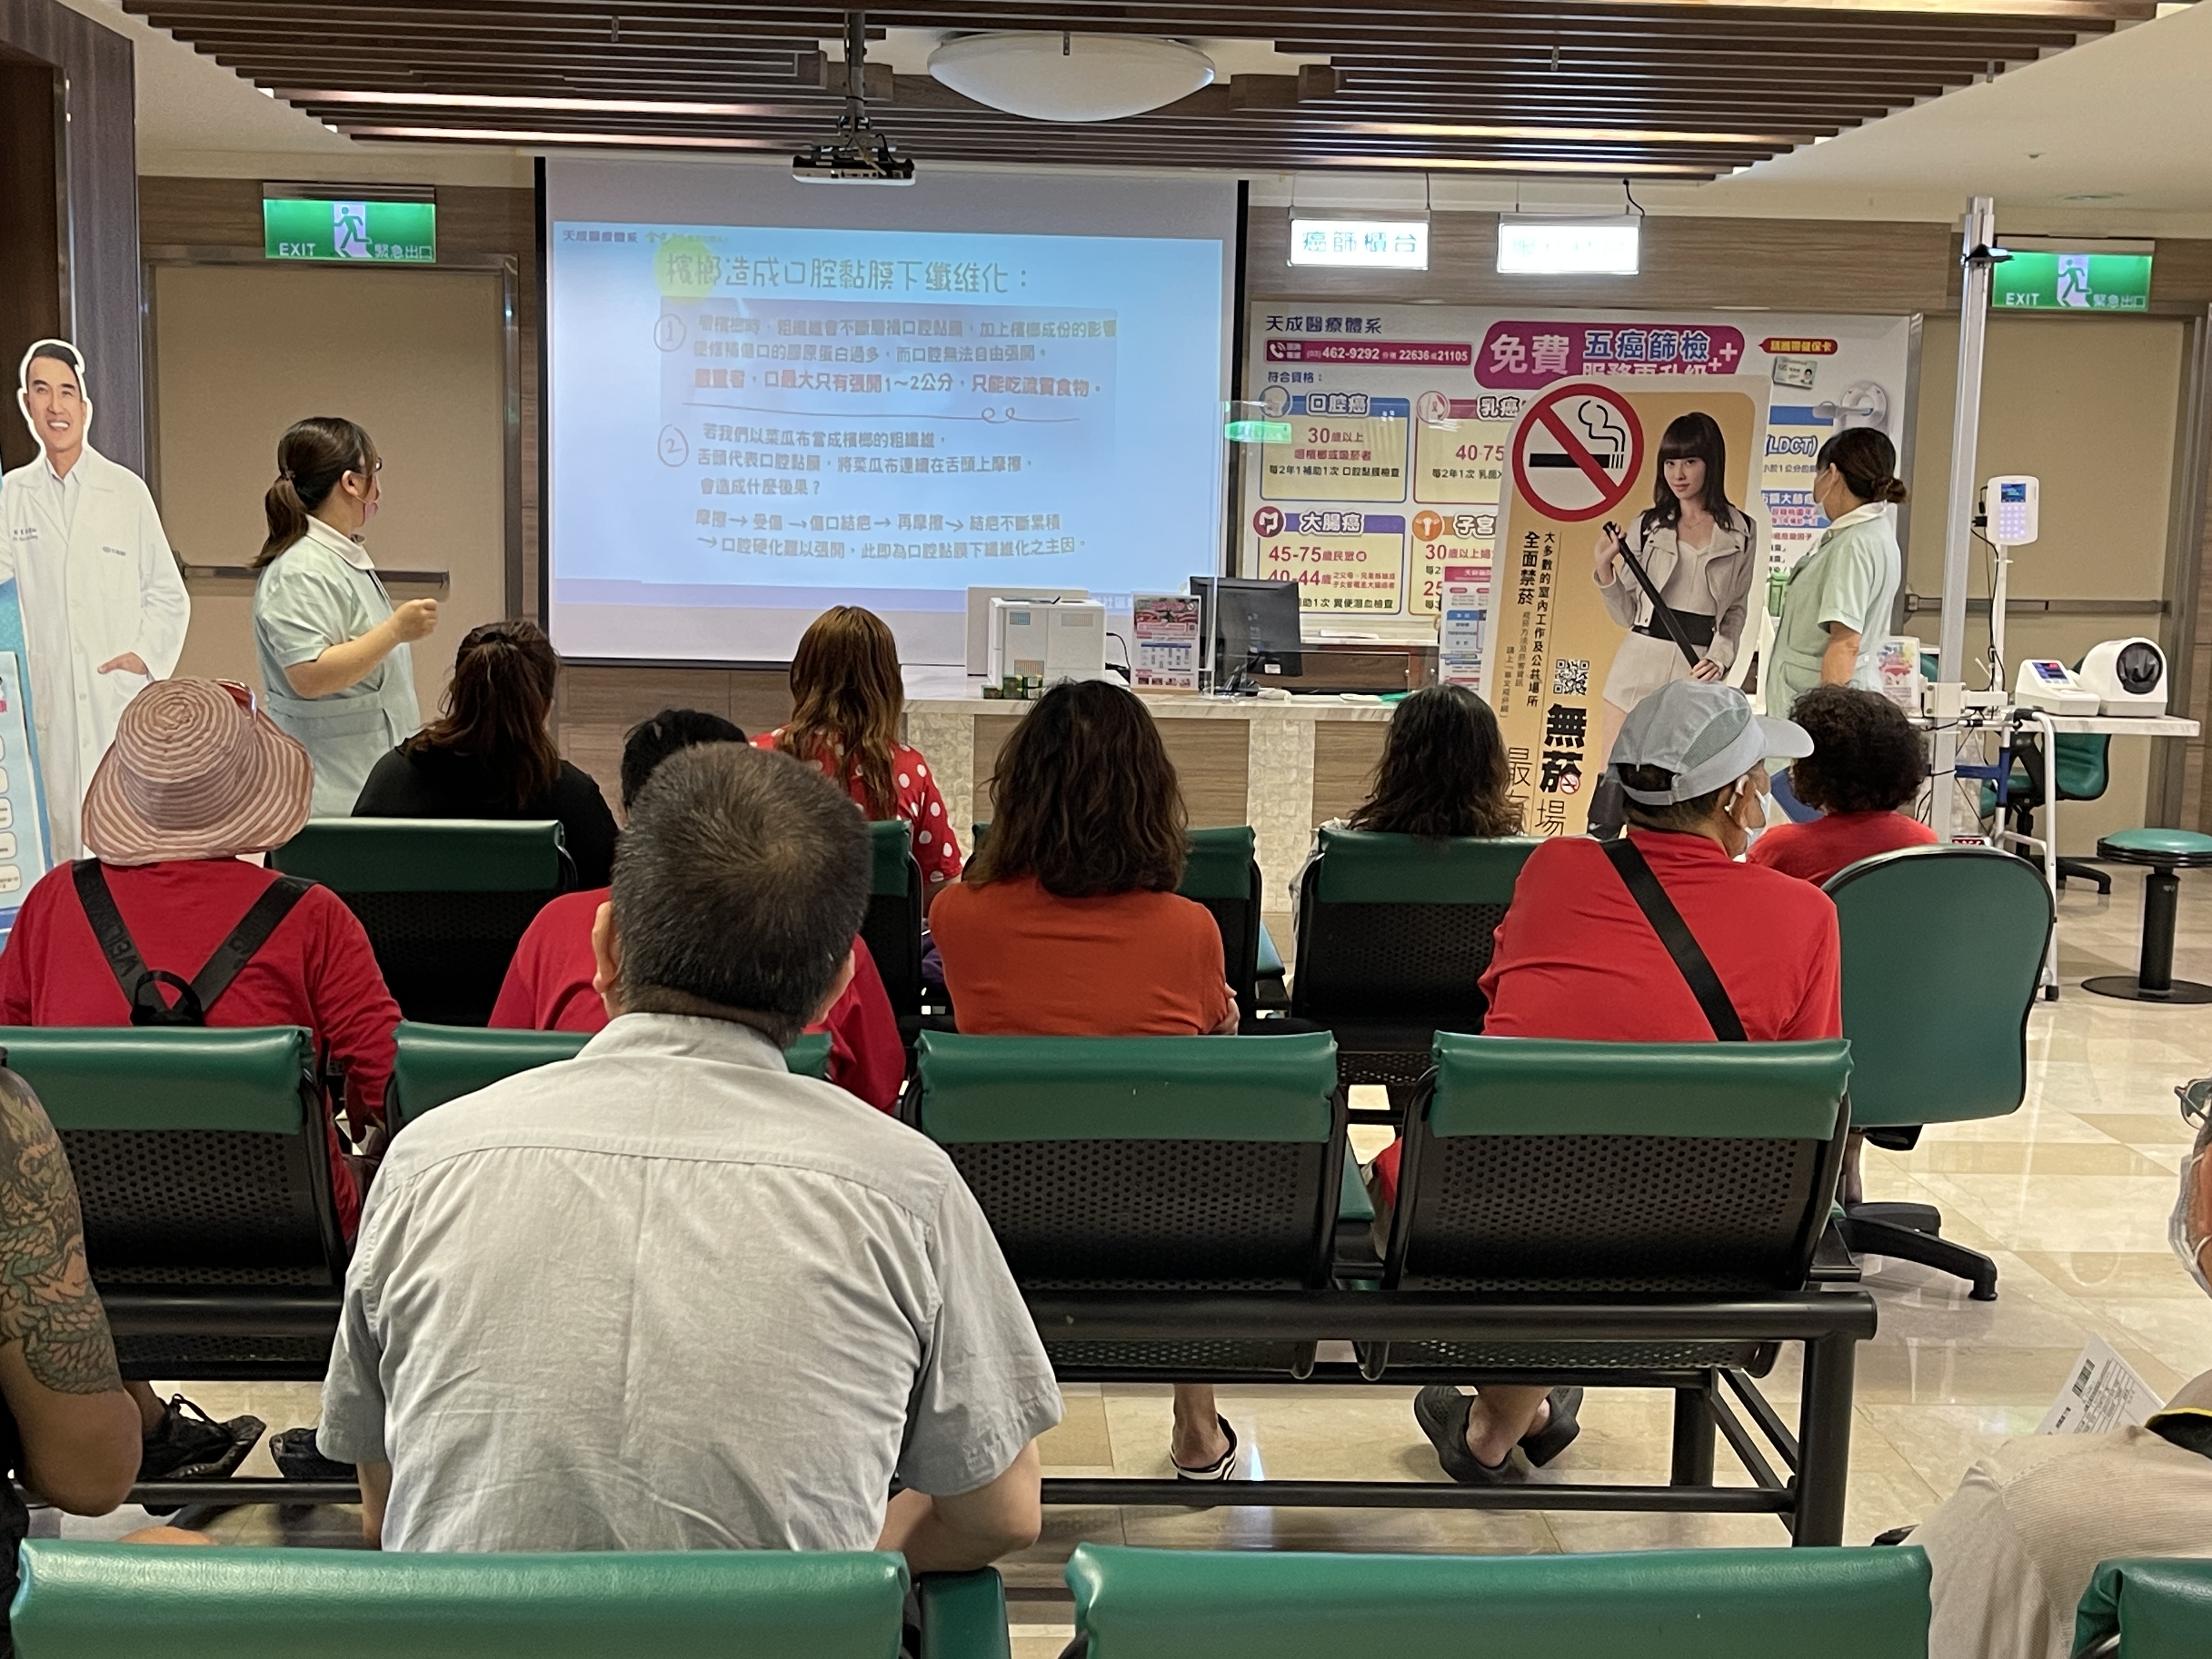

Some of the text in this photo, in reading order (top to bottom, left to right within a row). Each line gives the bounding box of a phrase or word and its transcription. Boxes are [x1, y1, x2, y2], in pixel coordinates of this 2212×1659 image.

[279, 242, 316, 256] EXIT
[374, 244, 432, 259] 緊急出口
[1302, 231, 1417, 253] 癌篩櫃台
[2006, 292, 2040, 306] EXIT
[1266, 315, 1382, 334] 天成醫療體系
[1489, 334, 1569, 376] 免費
[1583, 329, 1710, 362] 五癌篩檢
[1308, 393, 1368, 414] 口腔癌
[1480, 396, 1520, 418] 乳癌
[1307, 427, 1364, 444] 30歲以上
[1765, 435, 1818, 456] (LDCT)
[1301, 512, 1363, 534] 大腸癌
[1517, 531, 1540, 605] 全面禁菸
[1526, 532, 1555, 707] 大多數的室內工作及公共場所
